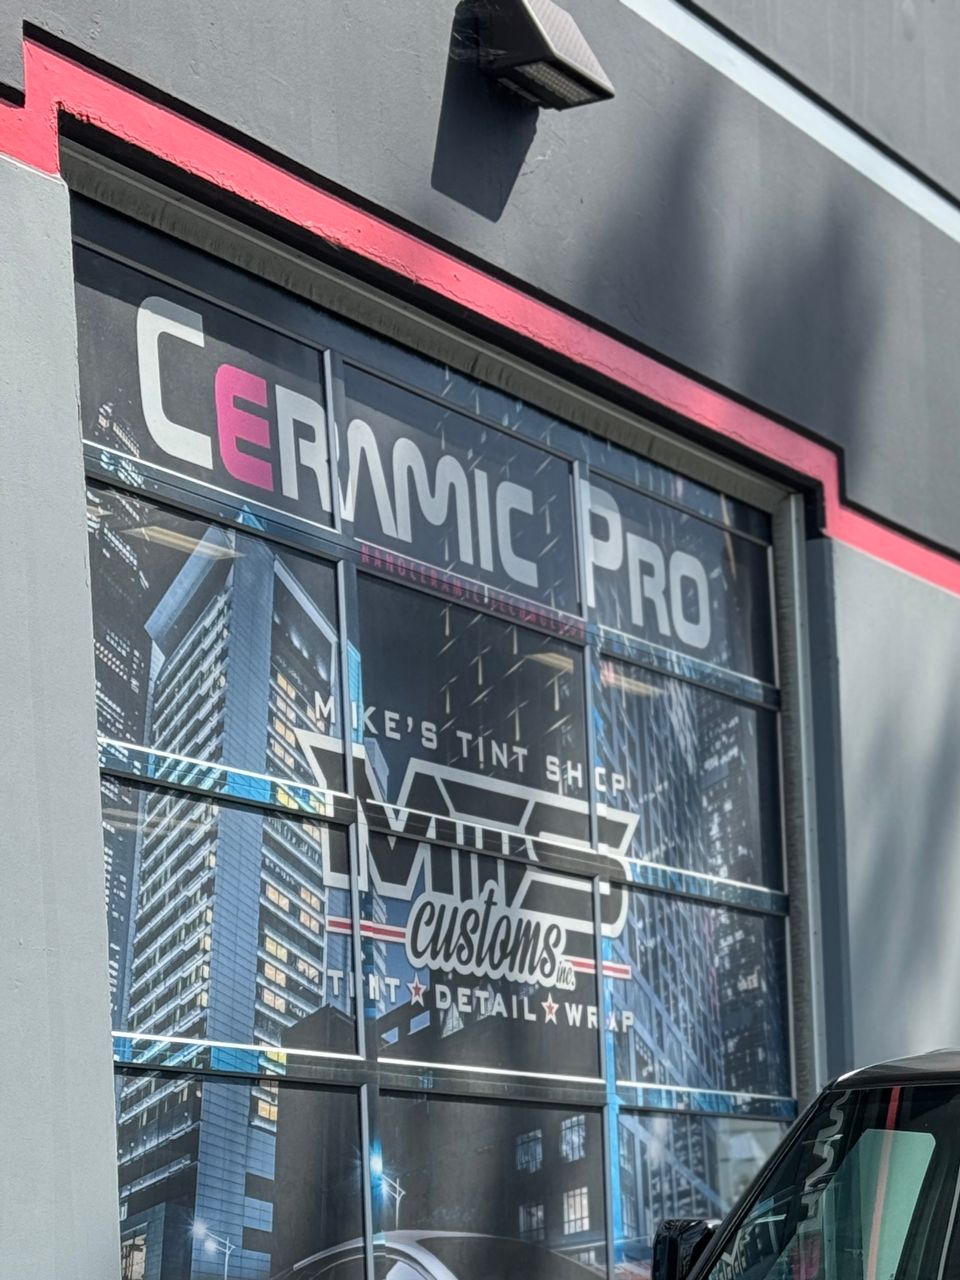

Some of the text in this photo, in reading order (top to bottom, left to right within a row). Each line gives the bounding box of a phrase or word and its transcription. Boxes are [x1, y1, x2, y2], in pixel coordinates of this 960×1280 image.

[136, 296, 711, 649] CERAMIC PRO
[314, 691, 625, 796] MIKE'S TINT SHOP
[327, 969, 634, 1033] TINT DETAIL WRAP
